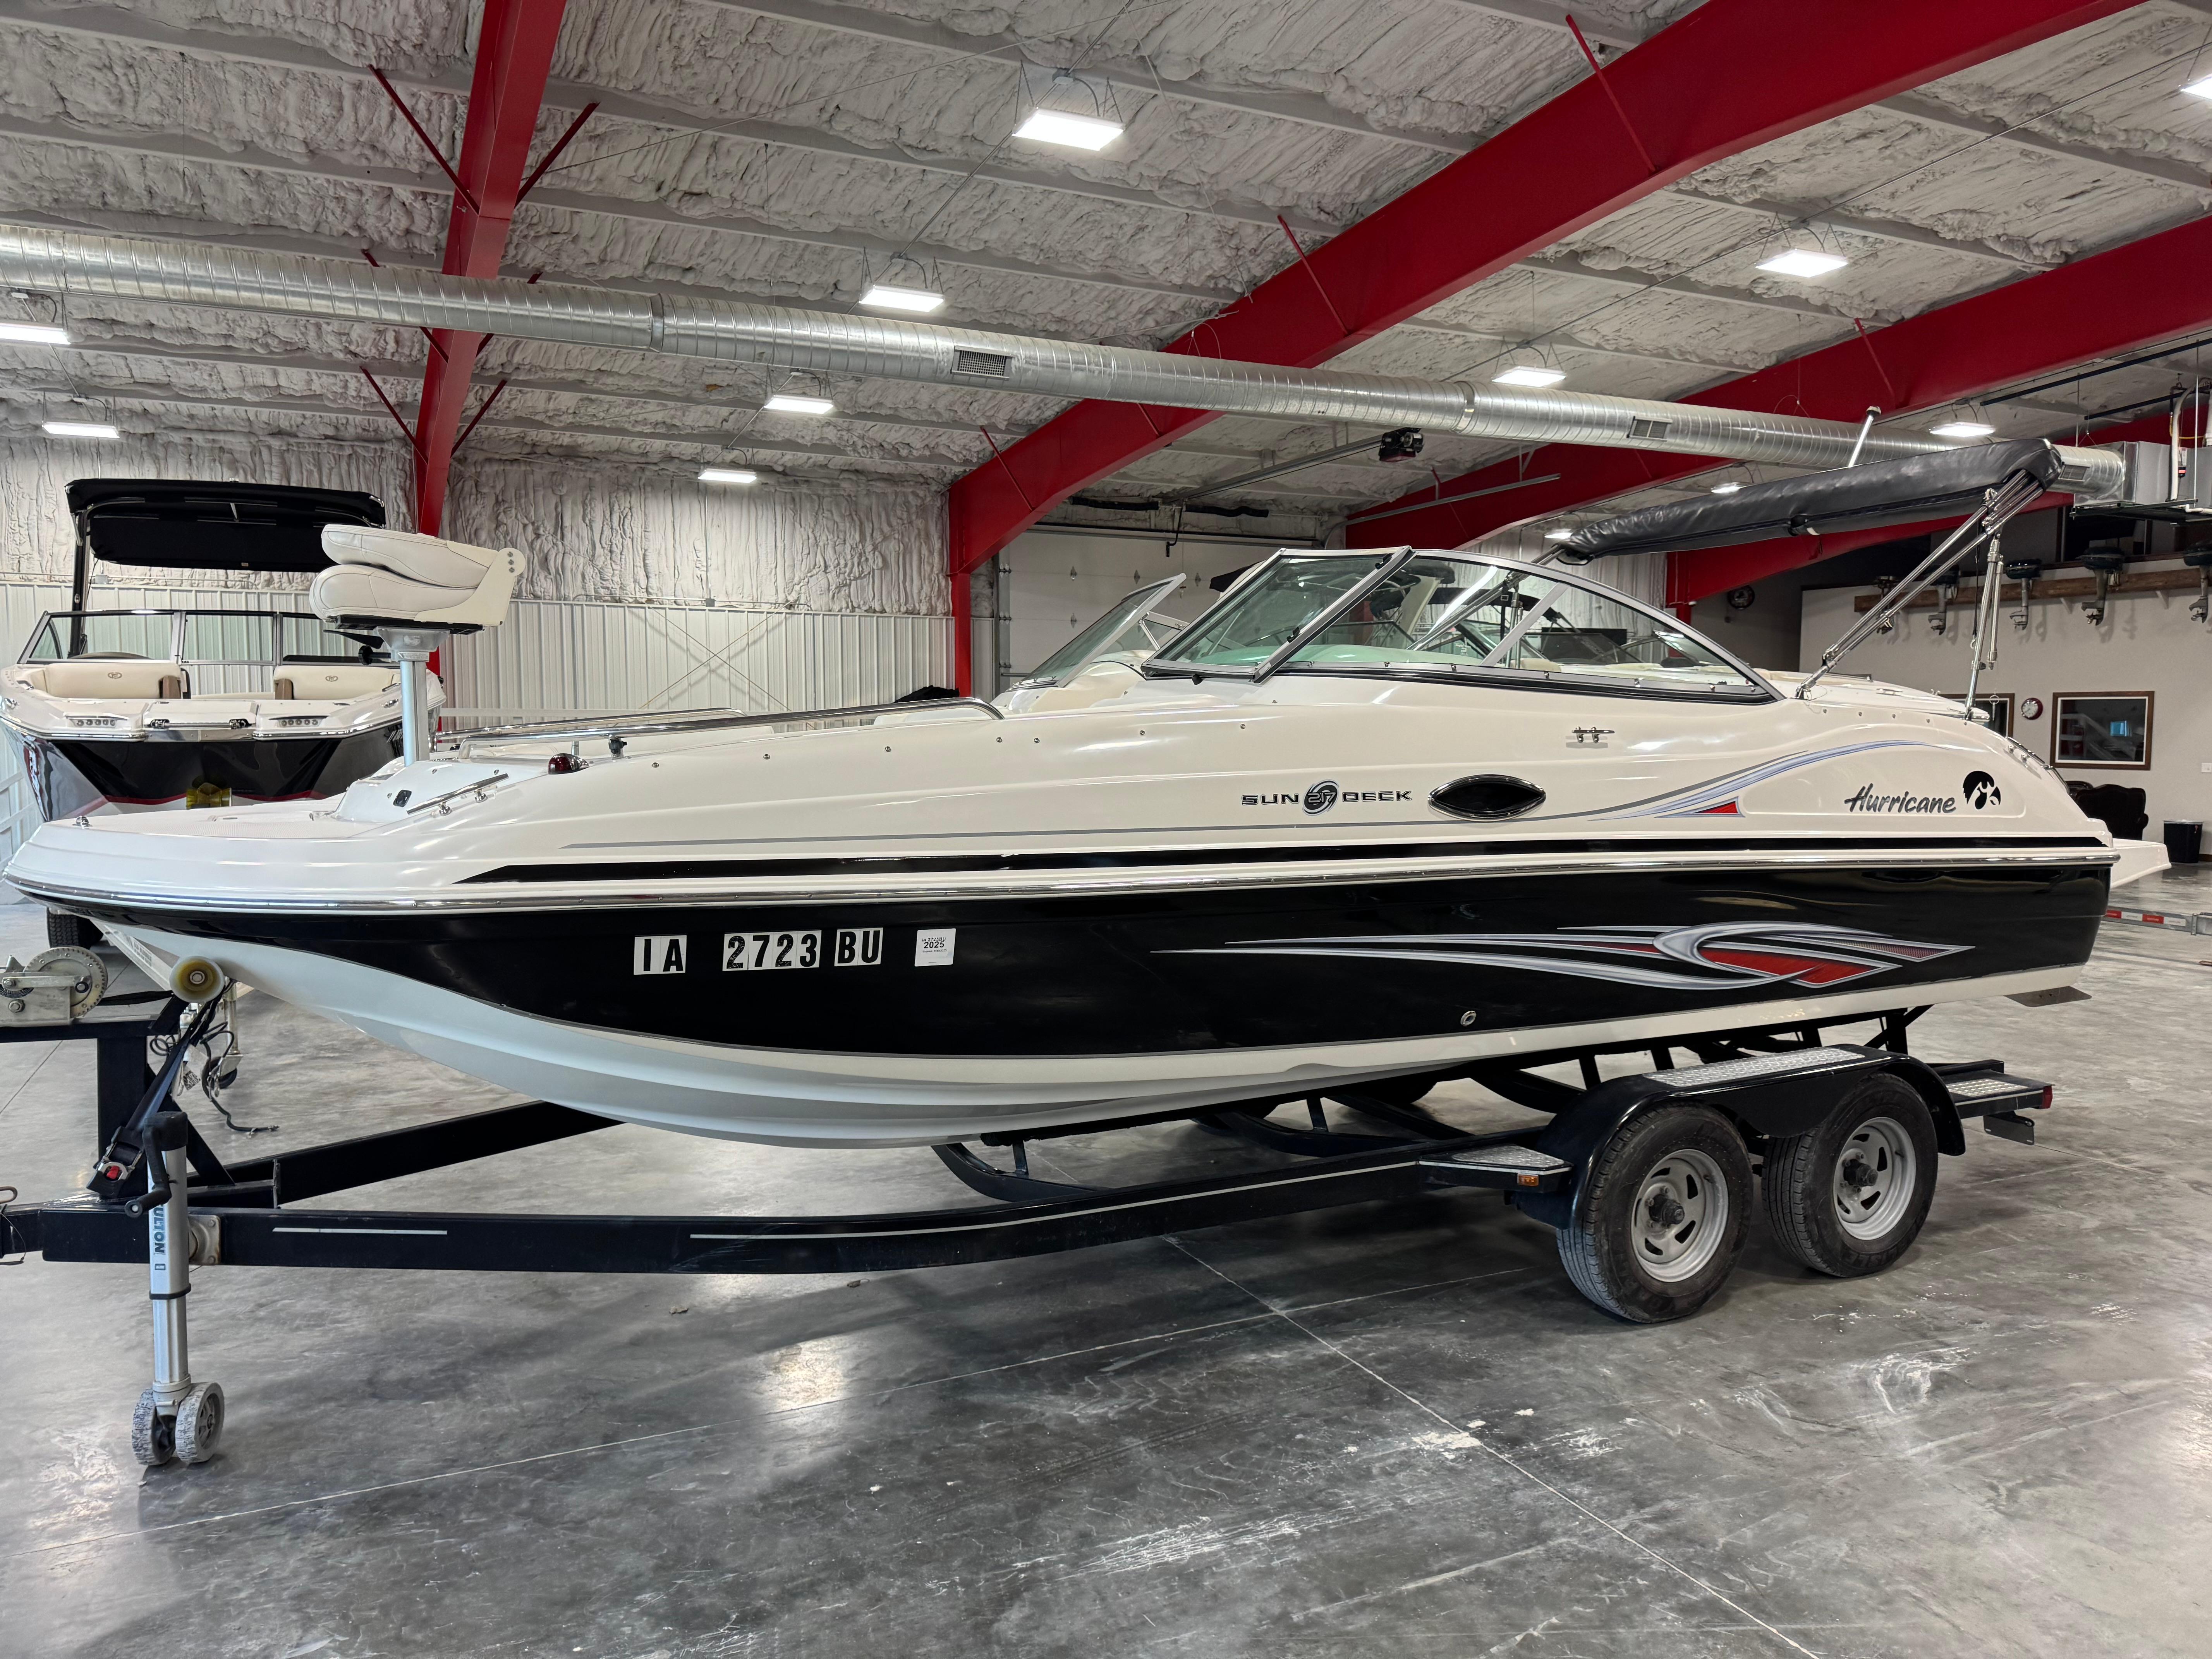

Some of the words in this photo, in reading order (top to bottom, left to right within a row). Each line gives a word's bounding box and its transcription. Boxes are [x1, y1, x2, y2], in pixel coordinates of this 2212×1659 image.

[1241, 793, 1299, 805] SUN
[1308, 792, 1336, 803] 217
[1342, 790, 1412, 802] DECK
[1844, 783, 1956, 813] Hurricane
[643, 938, 684, 972] IA
[726, 933, 817, 969] 2723
[837, 930, 881, 964] BU
[153, 1204, 166, 1254] ULTON
